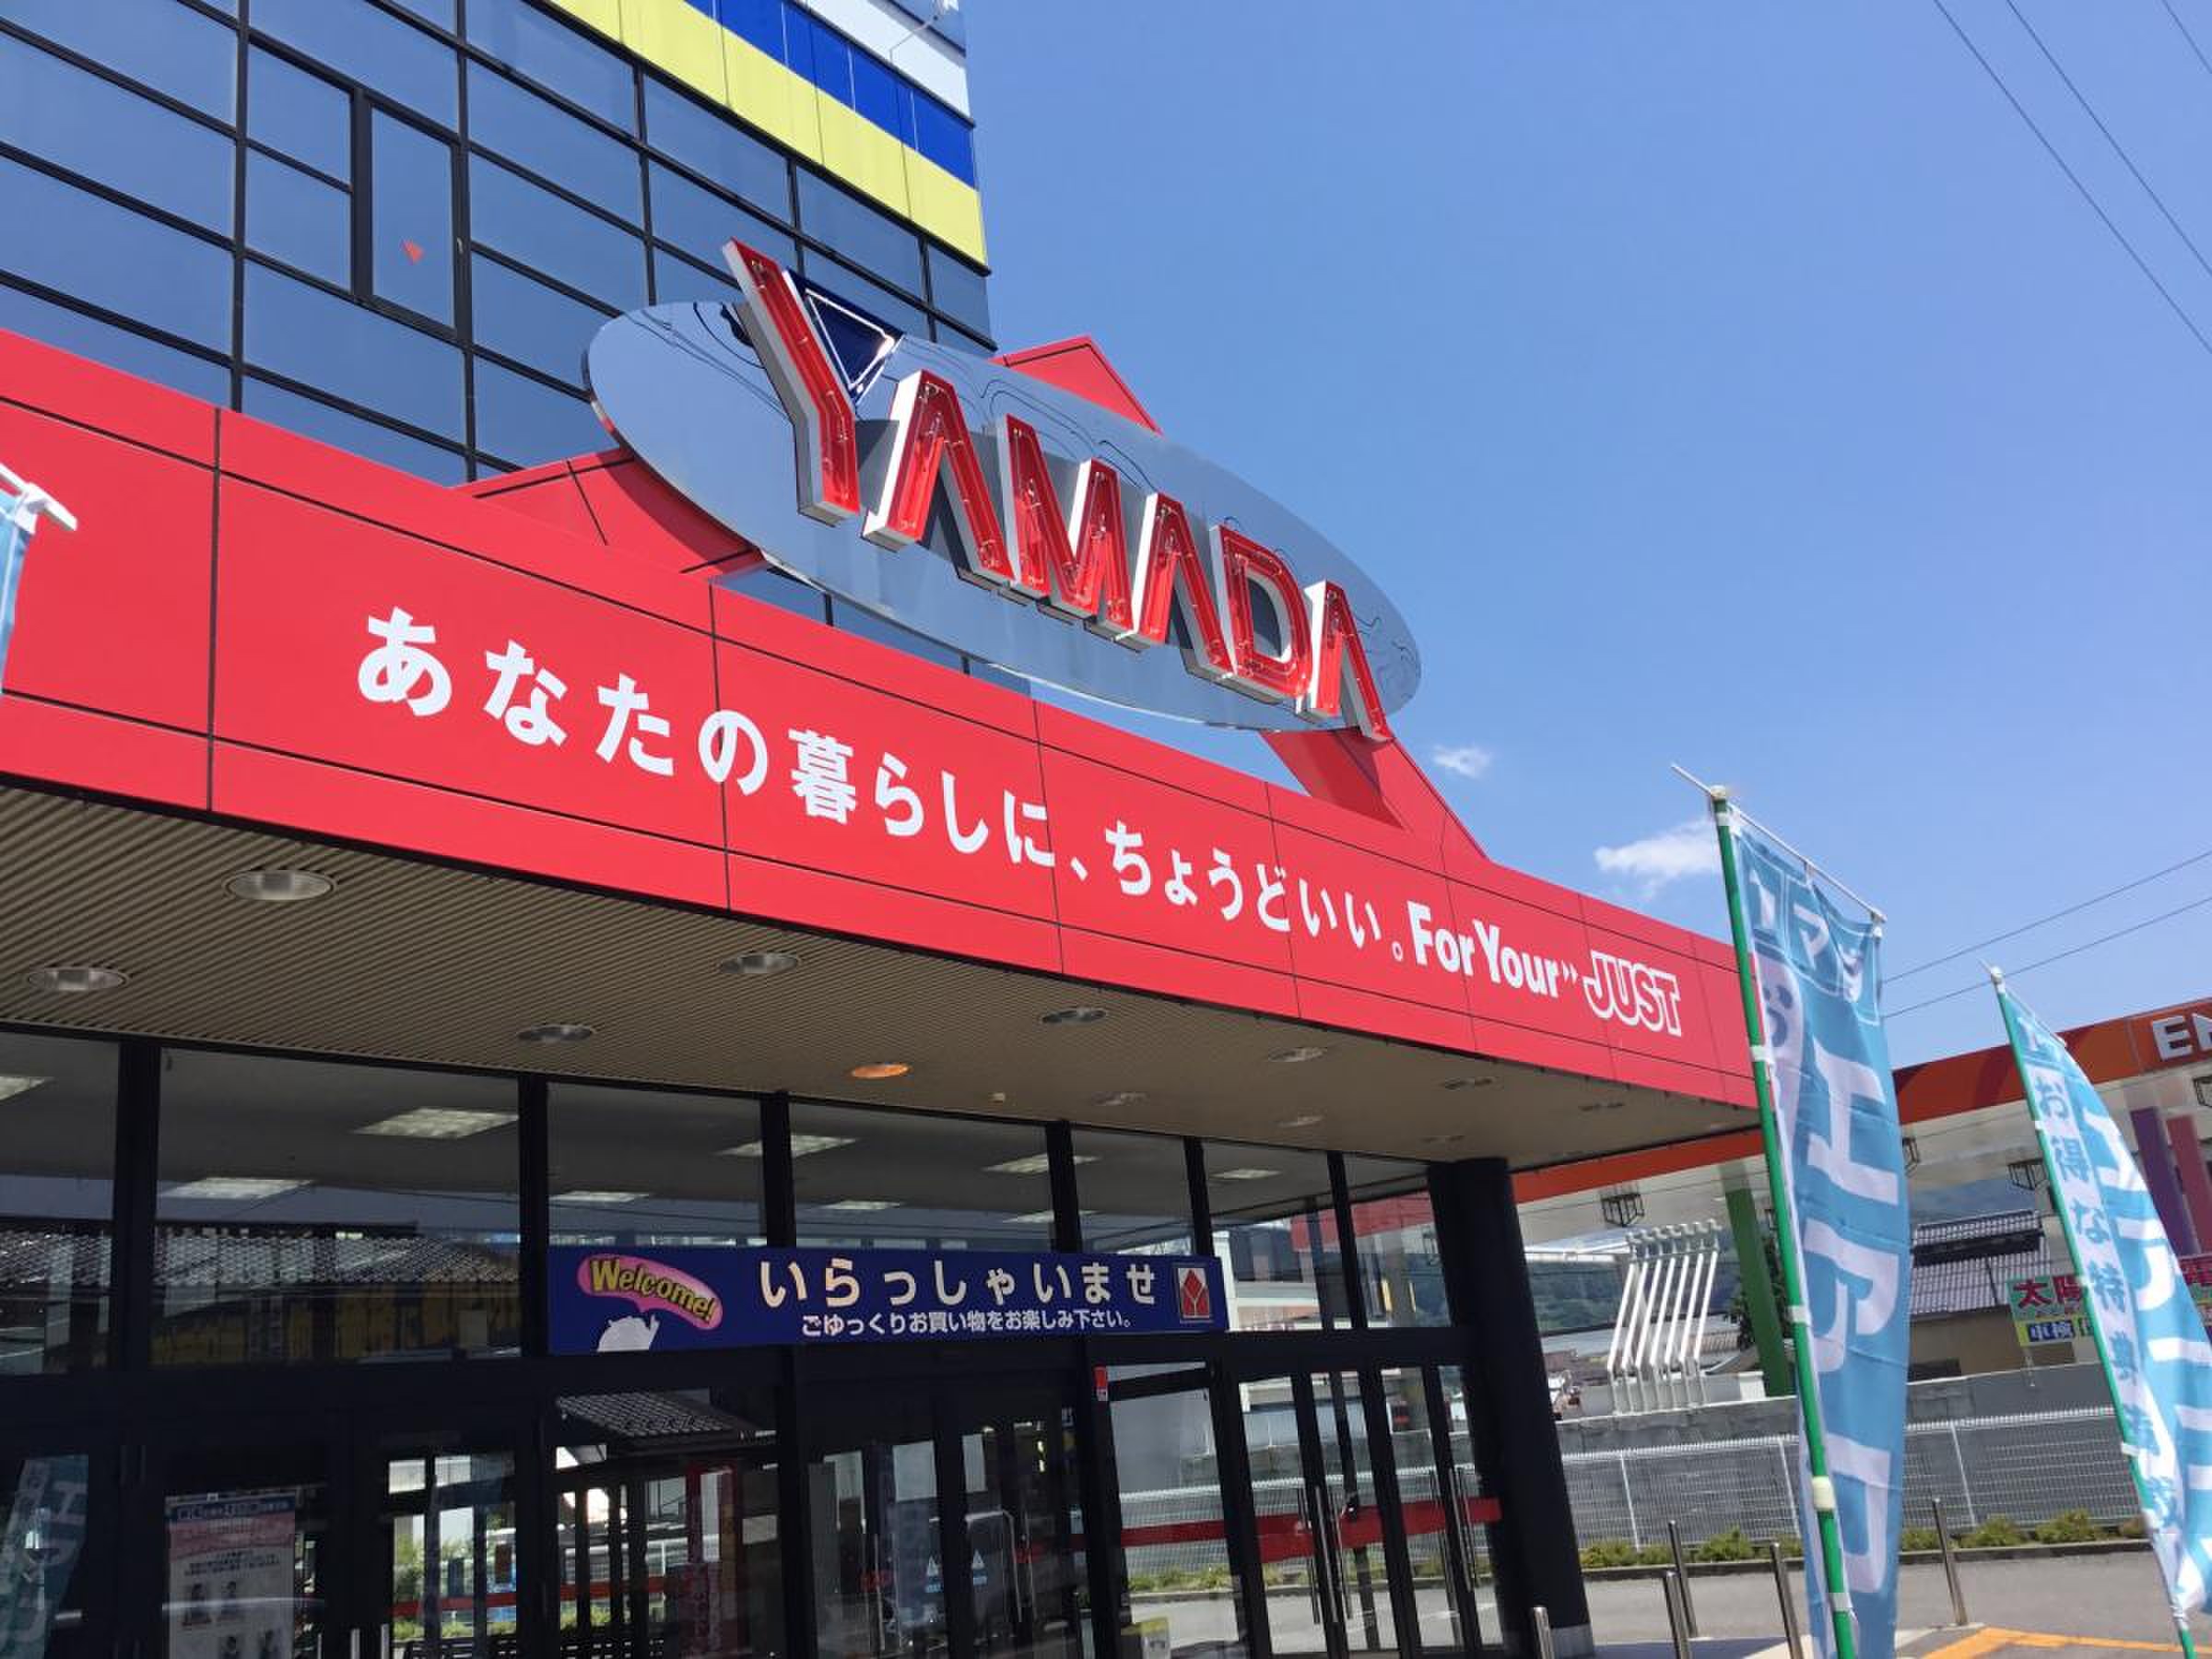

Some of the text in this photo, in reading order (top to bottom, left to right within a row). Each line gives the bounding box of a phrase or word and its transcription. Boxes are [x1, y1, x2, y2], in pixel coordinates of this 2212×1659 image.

[723, 238, 1391, 740] YAMADA
[1583, 949, 1681, 1037] JUST
[590, 1258, 718, 1323] Welcome!
[760, 1258, 1155, 1308] いらっしゃいませ
[802, 1310, 1132, 1335] ごゆっくりお買い物をお楽しみ下さい。
